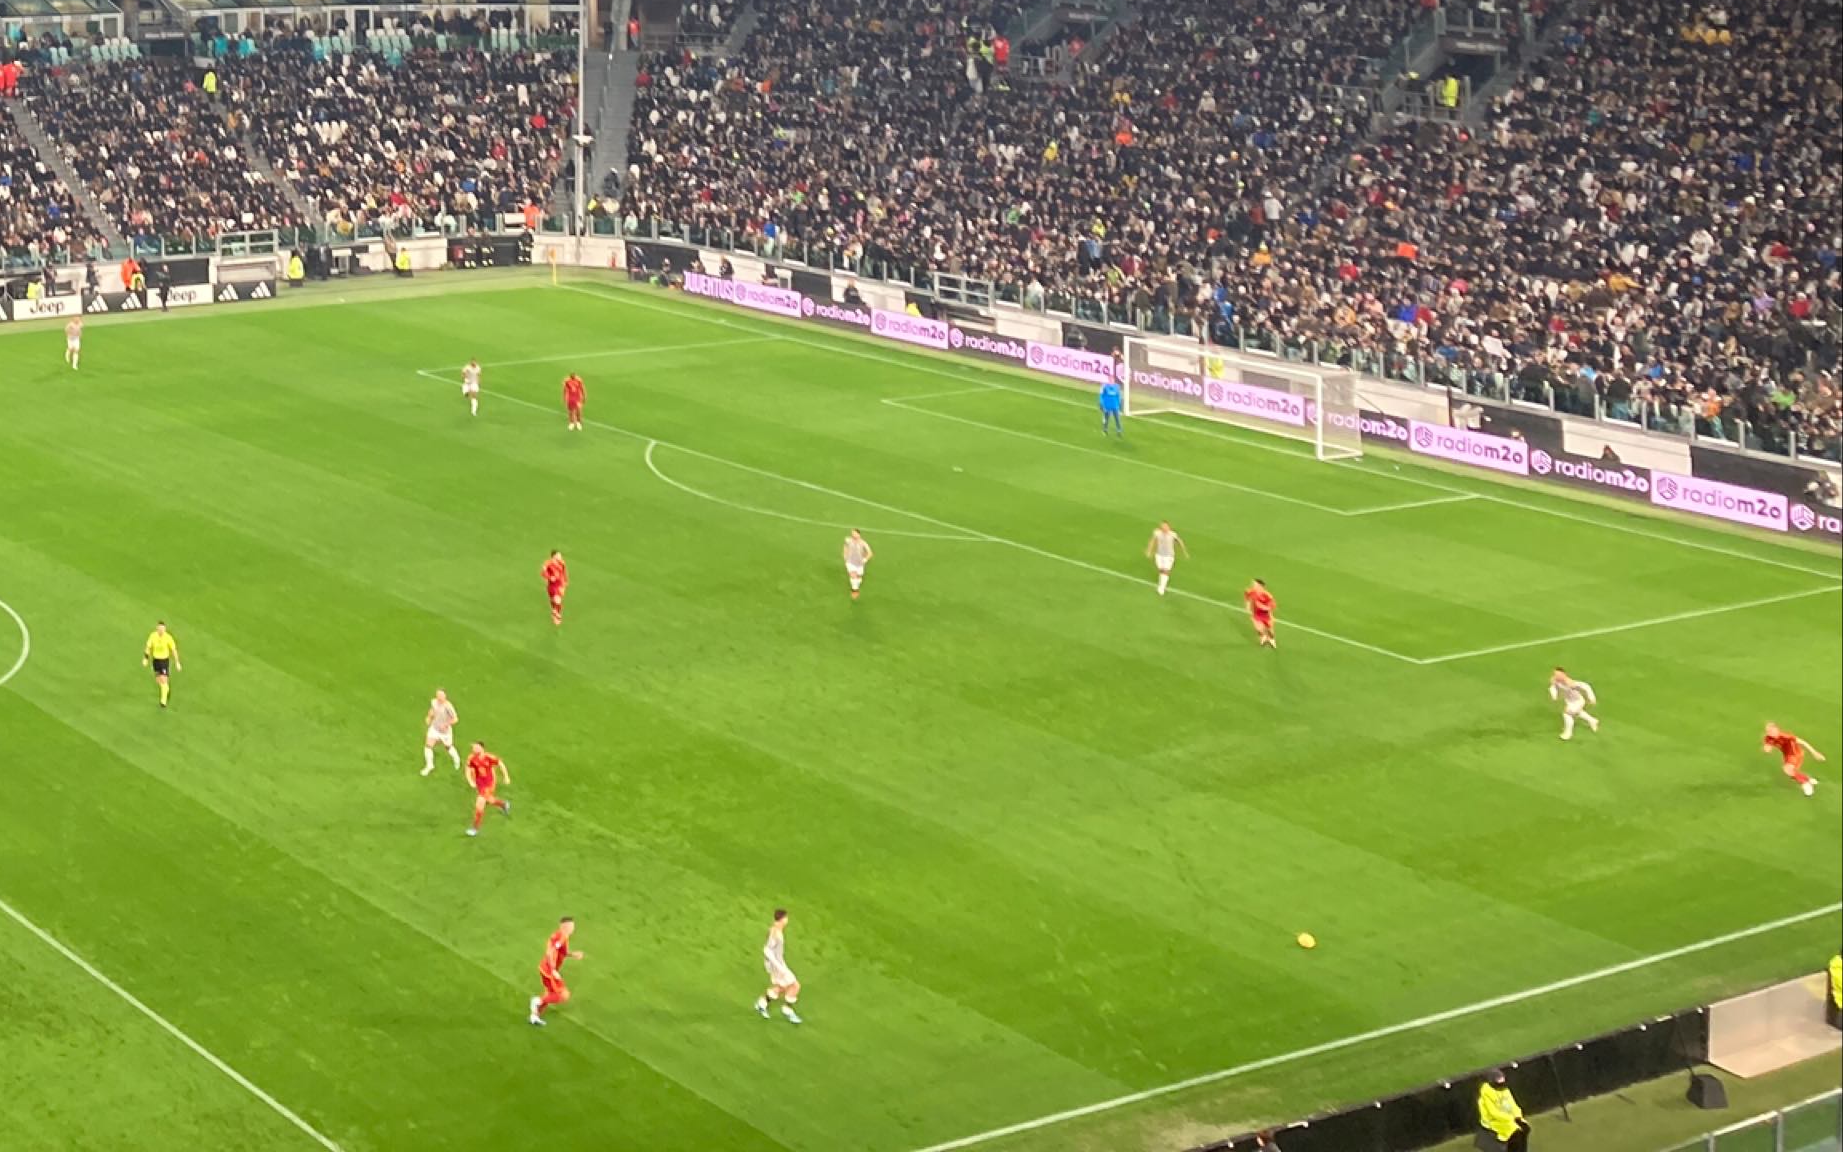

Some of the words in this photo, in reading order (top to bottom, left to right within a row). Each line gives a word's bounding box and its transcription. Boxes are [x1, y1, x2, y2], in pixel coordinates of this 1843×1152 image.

[29, 300, 65, 315] Jeep
[888, 318, 946, 340] radiom2o
[965, 334, 1026, 359] radiom2o
[1046, 351, 1111, 376] radiom2o
[1133, 370, 1203, 397] radiom2o
[1226, 389, 1300, 416] radiom2o
[1436, 435, 1524, 464] radiom2o
[1555, 459, 1650, 492] radiom2o
[1681, 486, 1781, 519] radiom2o
